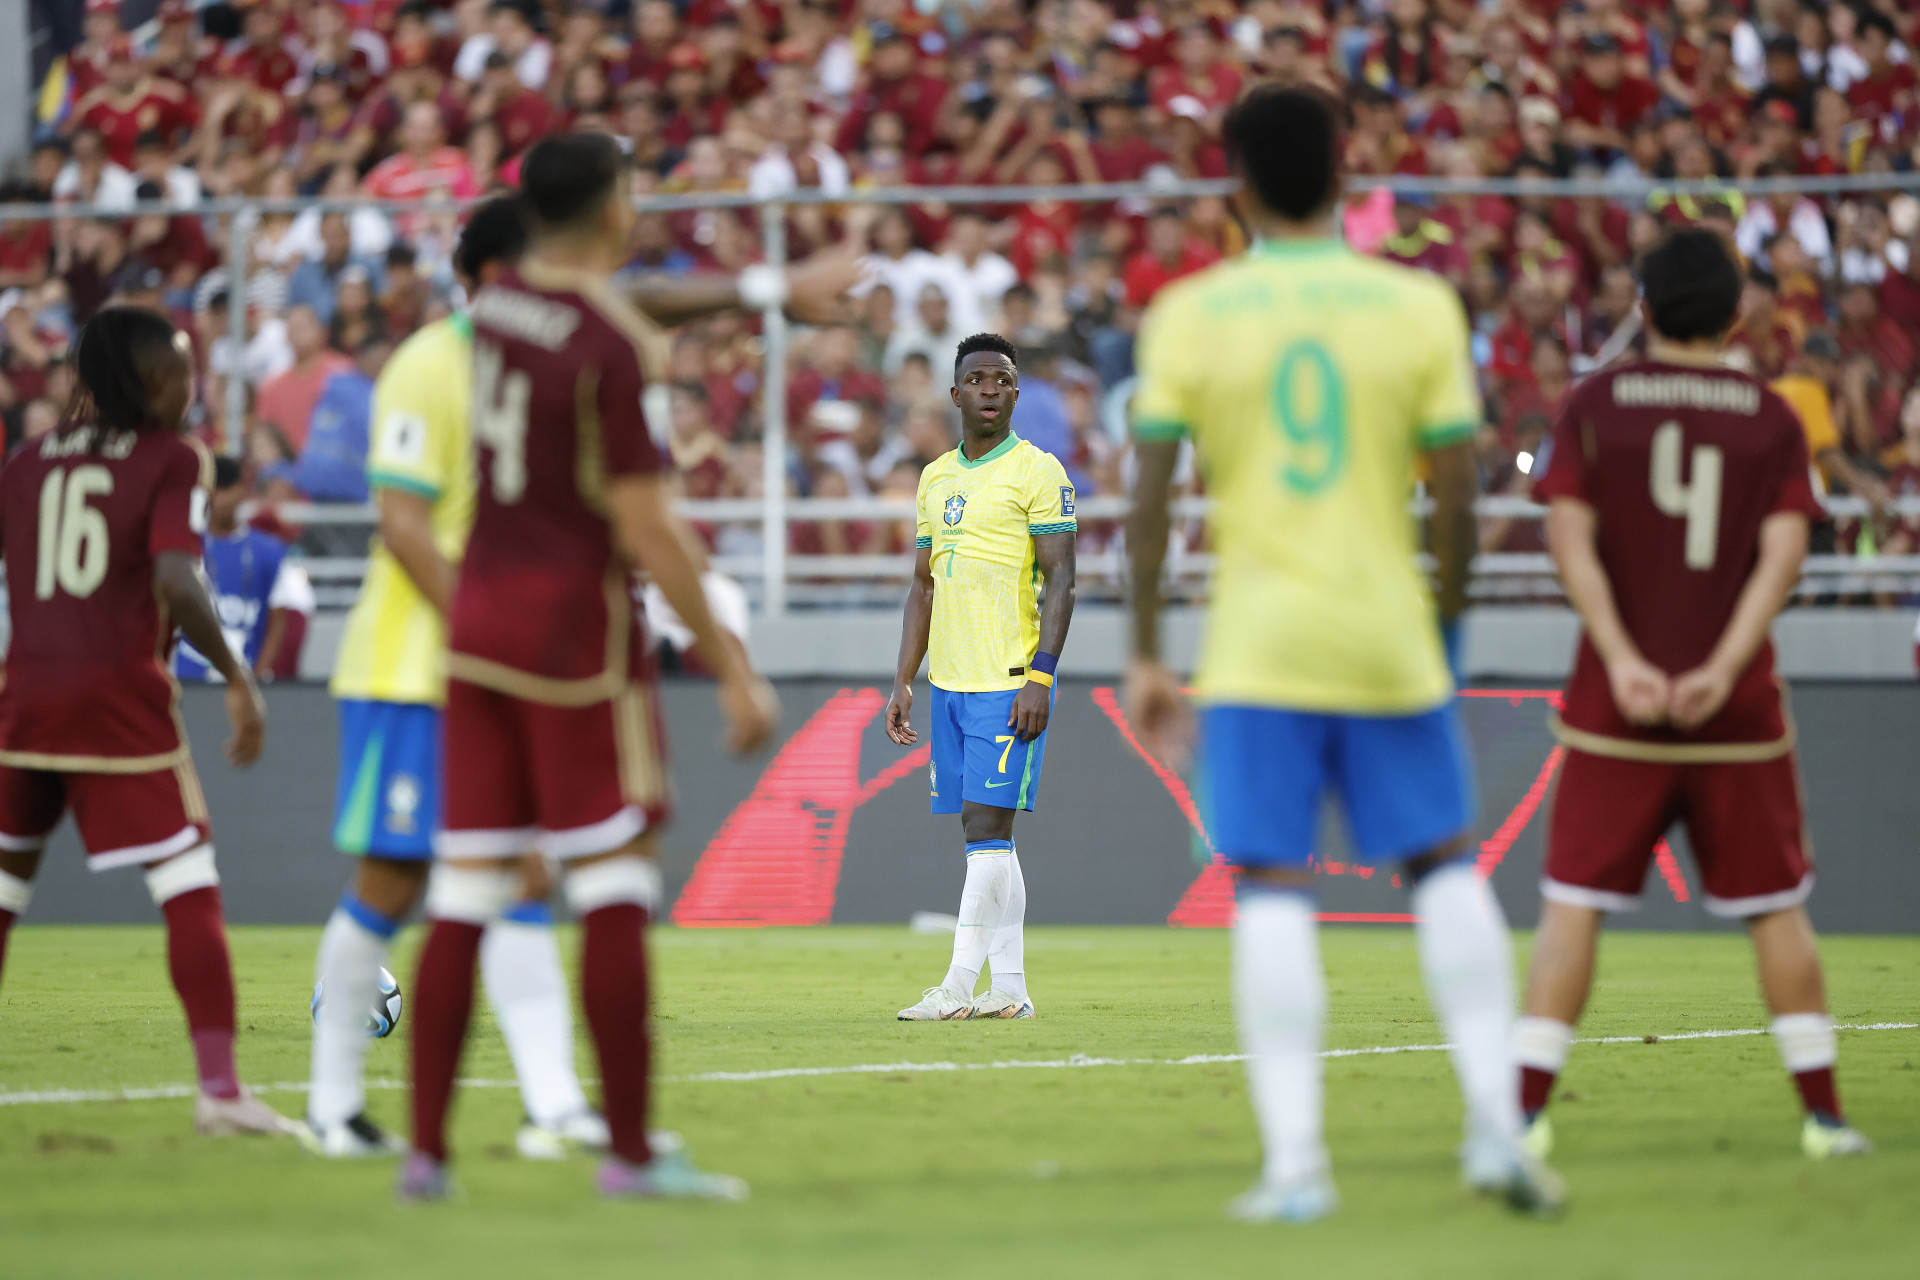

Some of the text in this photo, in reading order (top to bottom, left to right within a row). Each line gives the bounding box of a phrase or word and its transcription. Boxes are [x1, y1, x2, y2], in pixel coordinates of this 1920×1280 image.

[1273, 337, 1347, 496] 9
[35, 465, 114, 600] 16
[943, 543, 958, 578] 7
[1650, 419, 1724, 570] 4
[995, 735, 1015, 773] 7
